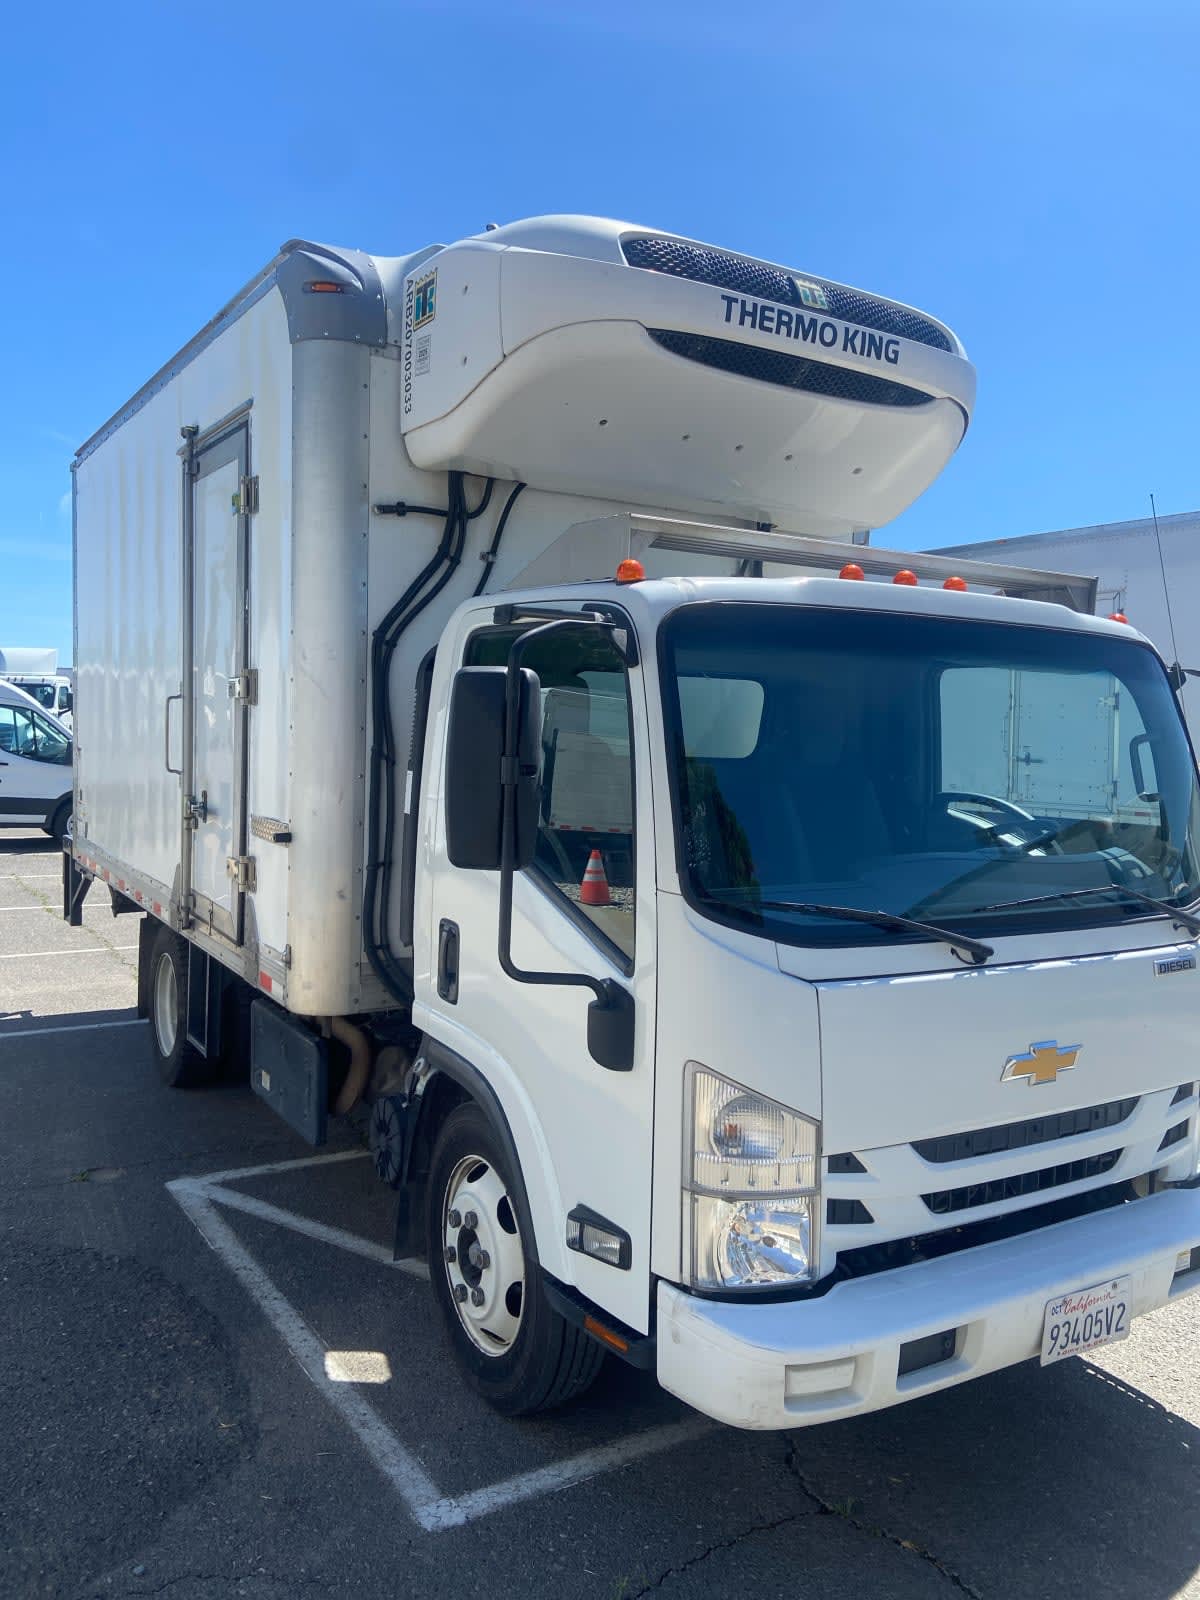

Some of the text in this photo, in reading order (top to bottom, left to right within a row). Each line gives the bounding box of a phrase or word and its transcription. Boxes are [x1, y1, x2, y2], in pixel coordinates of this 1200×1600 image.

[404, 279, 414, 414] ARB207003033
[721, 295, 900, 365] THERMO KING
[1160, 960, 1193, 973] DIESEL
[1048, 1302, 1126, 1355] 93405V2
[1064, 1292, 1116, 1315] California
